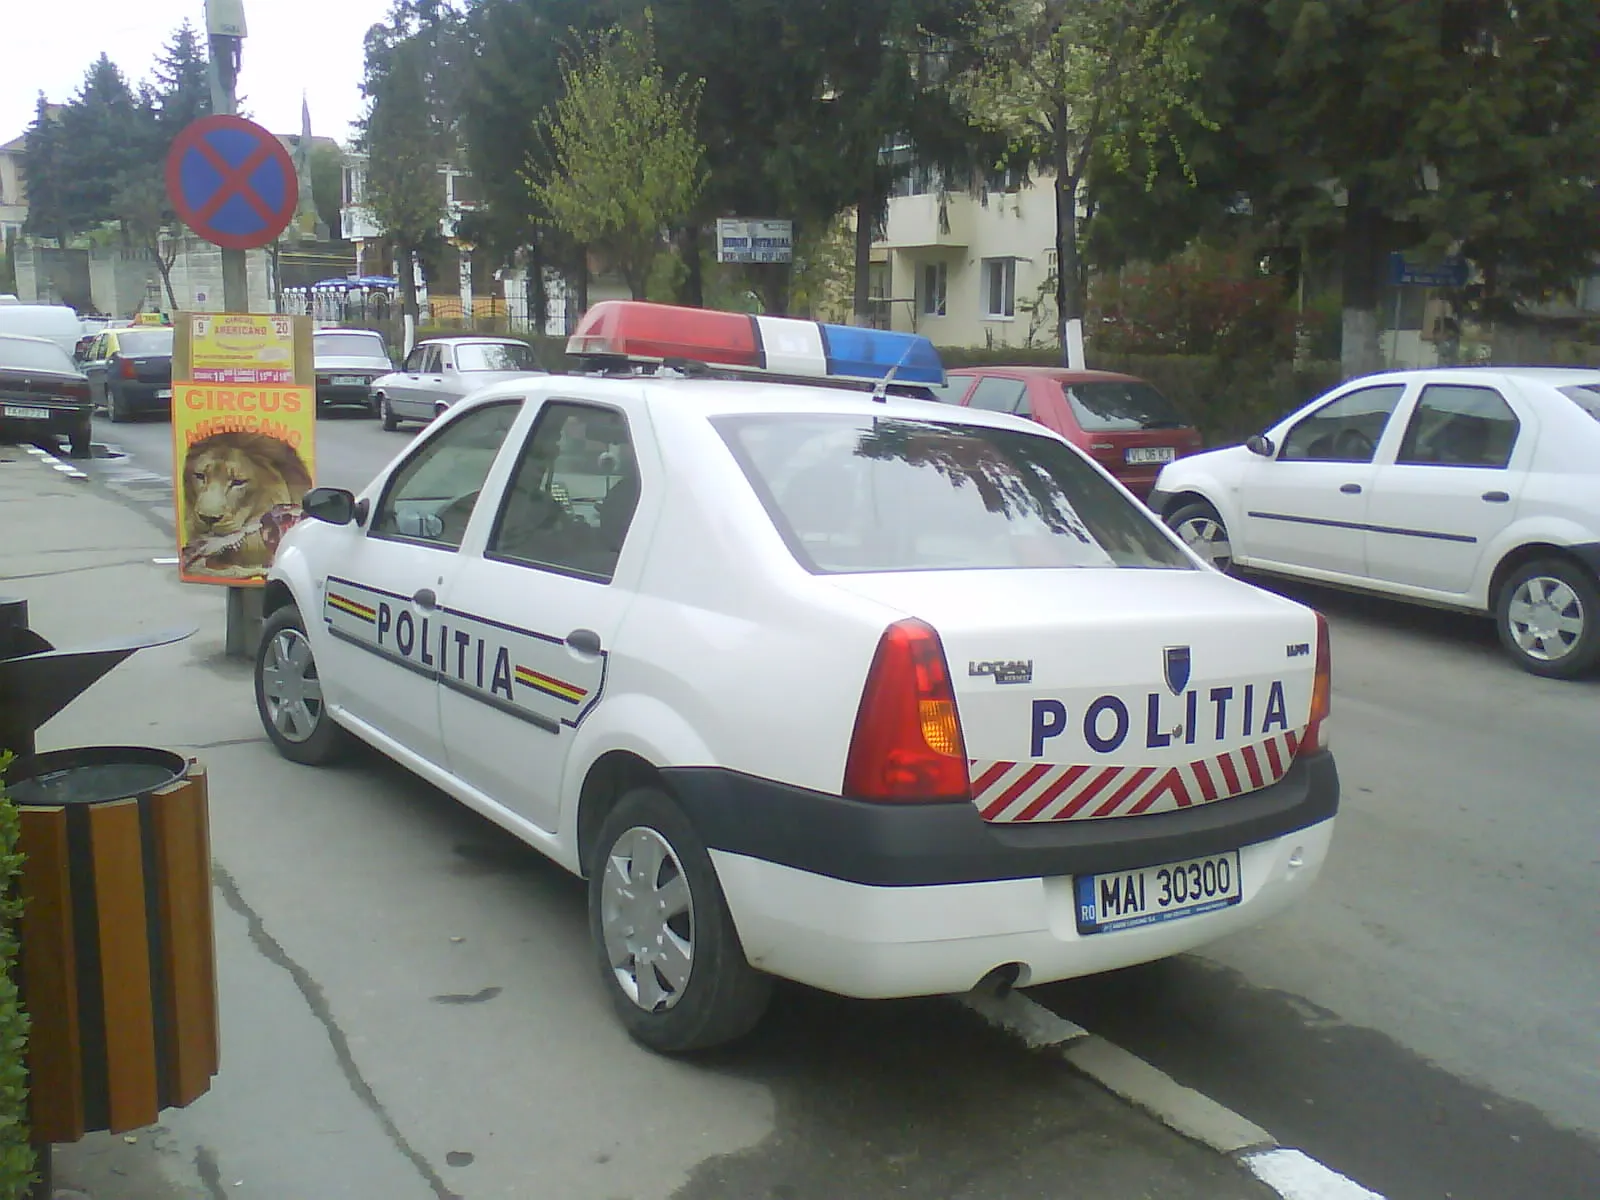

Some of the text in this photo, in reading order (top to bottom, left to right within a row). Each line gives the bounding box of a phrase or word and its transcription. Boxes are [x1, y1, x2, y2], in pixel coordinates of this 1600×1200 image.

[214, 326, 267, 335] AMERICANO
[276, 322, 289, 334] 20
[185, 390, 301, 412] CIRCUS
[185, 415, 302, 450] AMERICANO
[377, 602, 514, 701] POLITIA
[1030, 680, 1288, 757] POLITIA
[1101, 873, 1145, 918] MAI
[1156, 857, 1230, 907] 30300
[1081, 904, 1096, 921] RO
